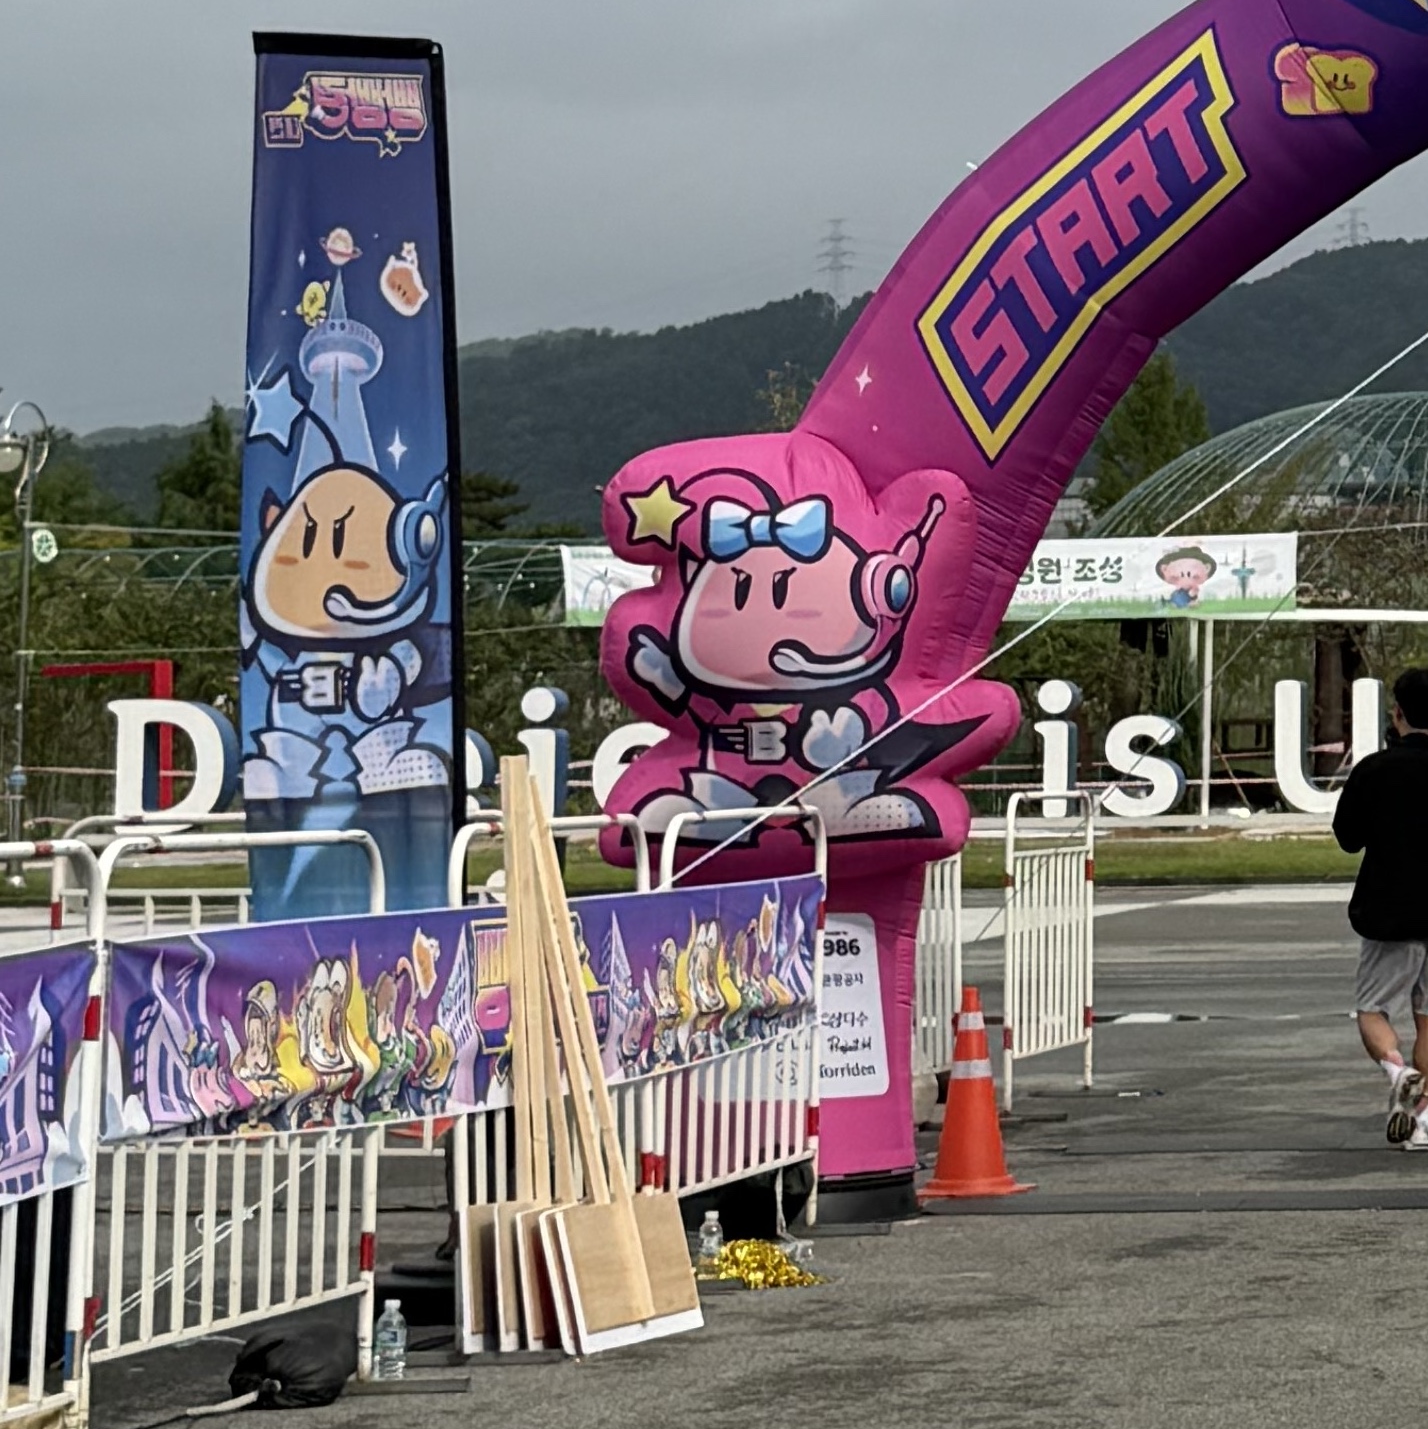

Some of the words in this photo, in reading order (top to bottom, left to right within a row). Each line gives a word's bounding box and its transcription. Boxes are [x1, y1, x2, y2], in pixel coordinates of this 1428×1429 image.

[948, 77, 1212, 404] START
[1073, 555, 1124, 583] 조성
[1034, 680, 1187, 818] is
[823, 938, 861, 957] 986
